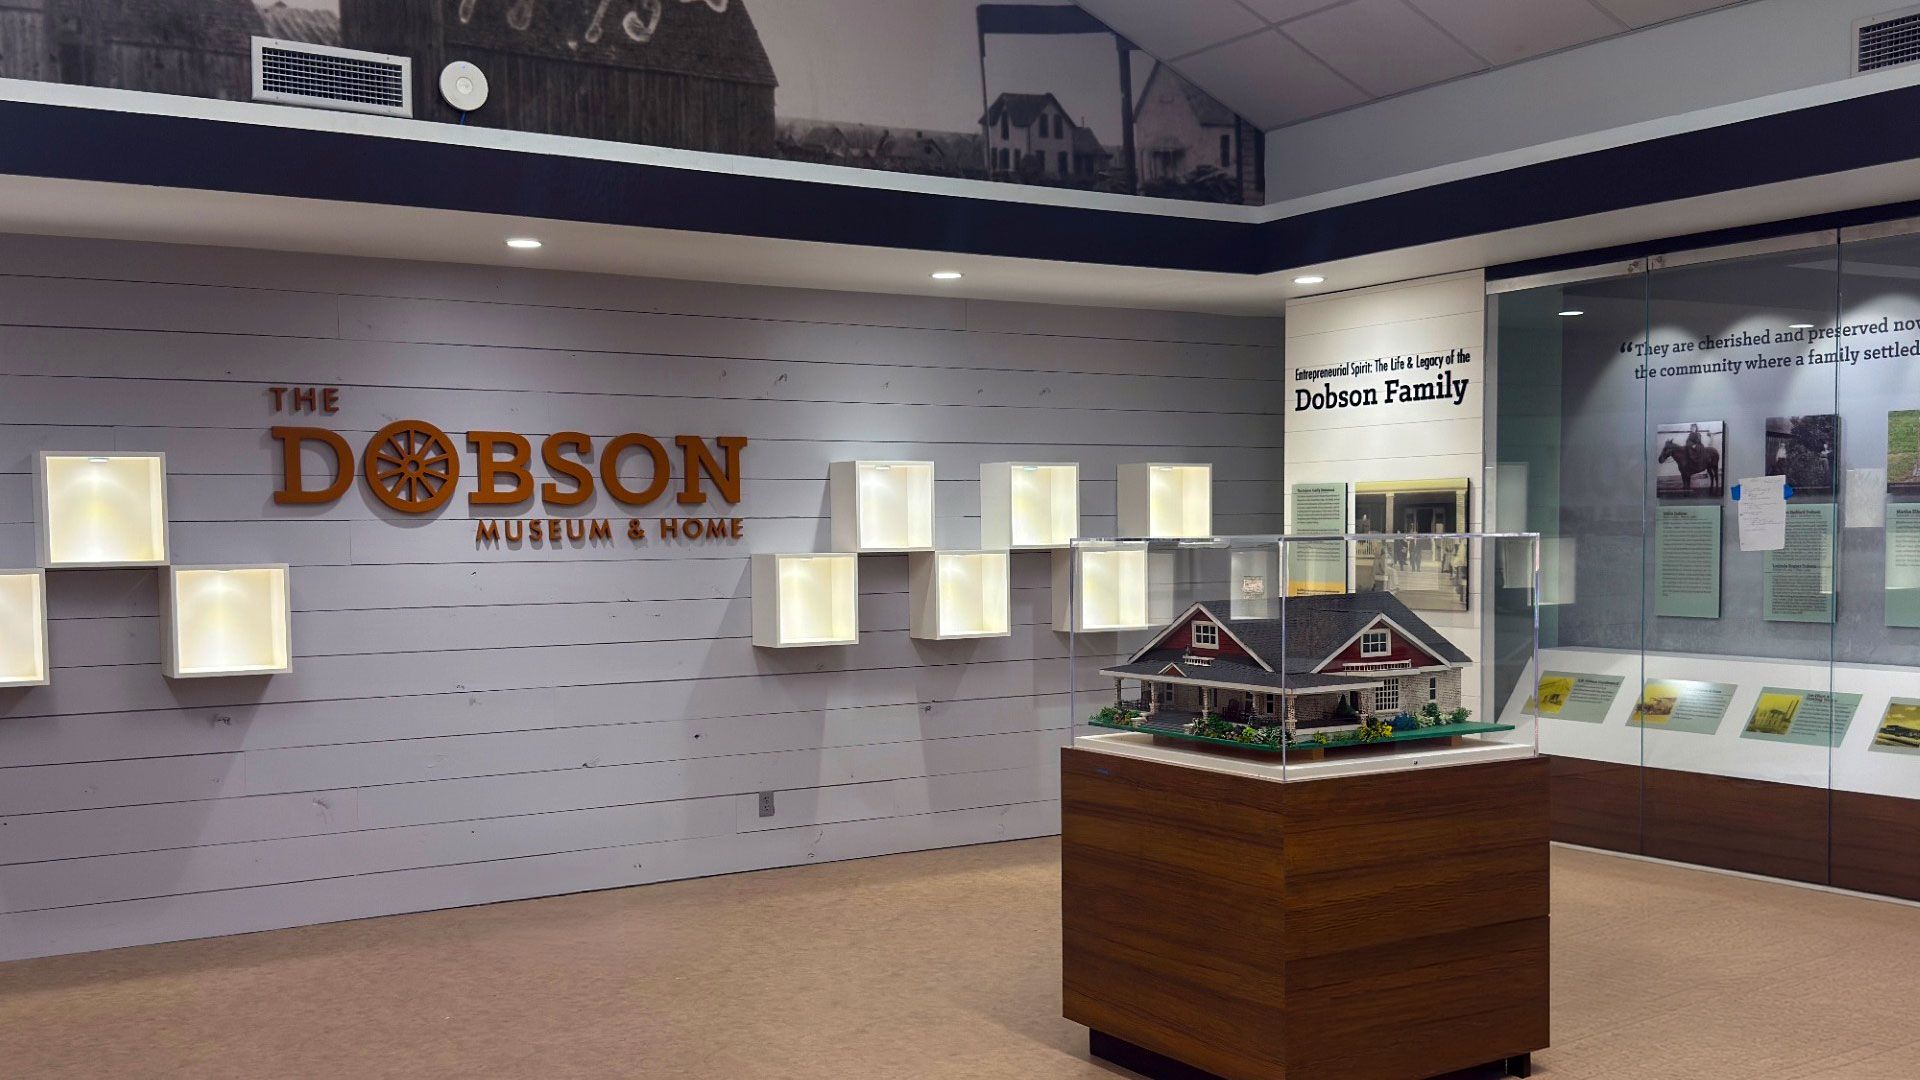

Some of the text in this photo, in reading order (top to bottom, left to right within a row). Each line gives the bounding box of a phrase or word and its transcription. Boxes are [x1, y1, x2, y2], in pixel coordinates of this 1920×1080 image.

[1672, 341, 1694, 353] are
[1698, 328, 1770, 351] cherished
[1774, 327, 1804, 343] and
[1807, 316, 1889, 344] preserved
[1295, 349, 1471, 382] Entrepreneurial Spirit: The Life & Legacy of the
[1634, 339, 1920, 379] the community where a family settled
[270, 387, 340, 413] THE
[1295, 370, 1470, 411] Dobson Family
[271, 419, 748, 513] DOBSON
[476, 518, 744, 542] MUSEUM & HOME
